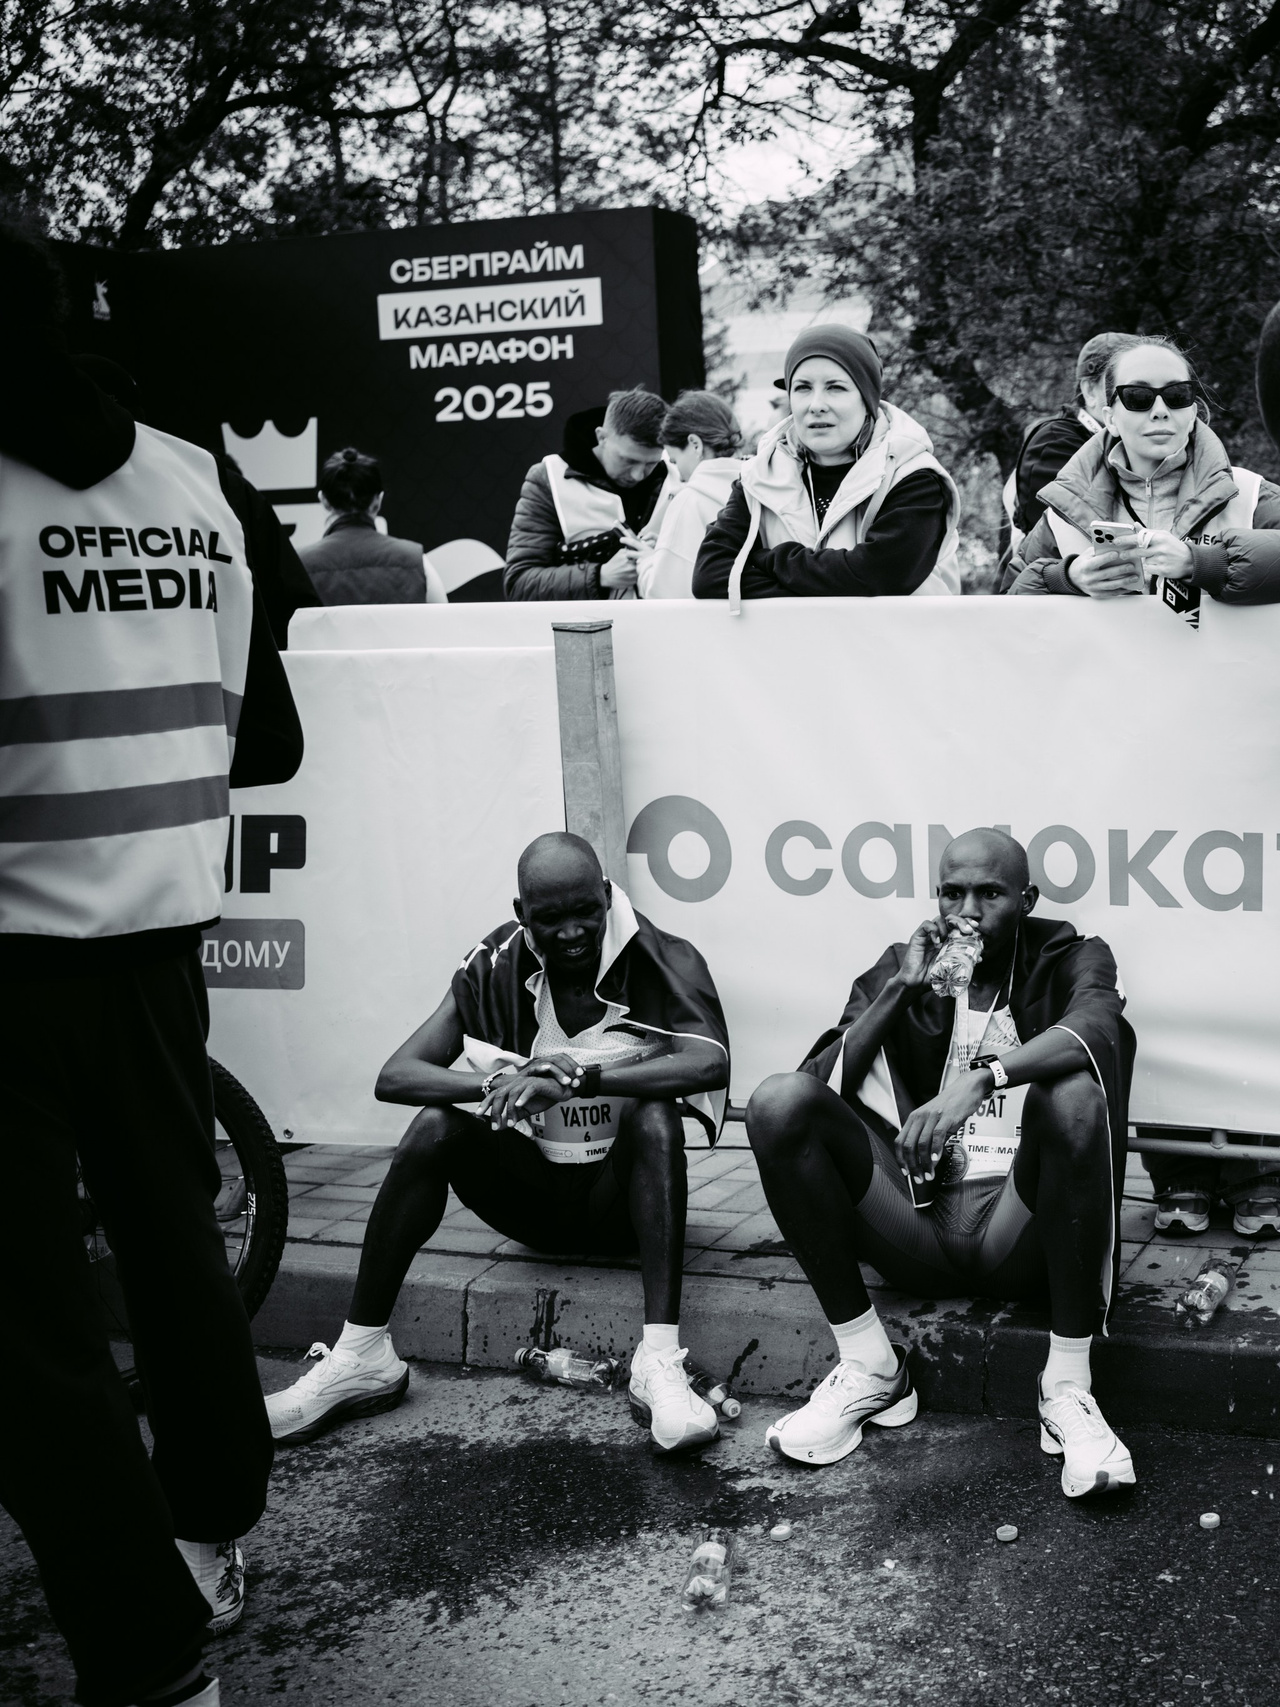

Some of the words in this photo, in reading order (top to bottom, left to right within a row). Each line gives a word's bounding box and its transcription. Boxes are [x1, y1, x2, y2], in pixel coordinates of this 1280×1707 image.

[389, 240, 585, 284] СБЕРПРАЙМ
[393, 288, 586, 330] КАЗАНСКИЙ
[409, 334, 575, 369] МАРАФОН
[434, 381, 554, 422] 2025
[39, 525, 233, 564] OFFICIAL
[42, 568, 218, 614] MEDIA
[202, 940, 291, 973] ДОМУ
[560, 1103, 612, 1127] YATOR
[969, 1122, 976, 1135] 5
[584, 1131, 591, 1142] 6
